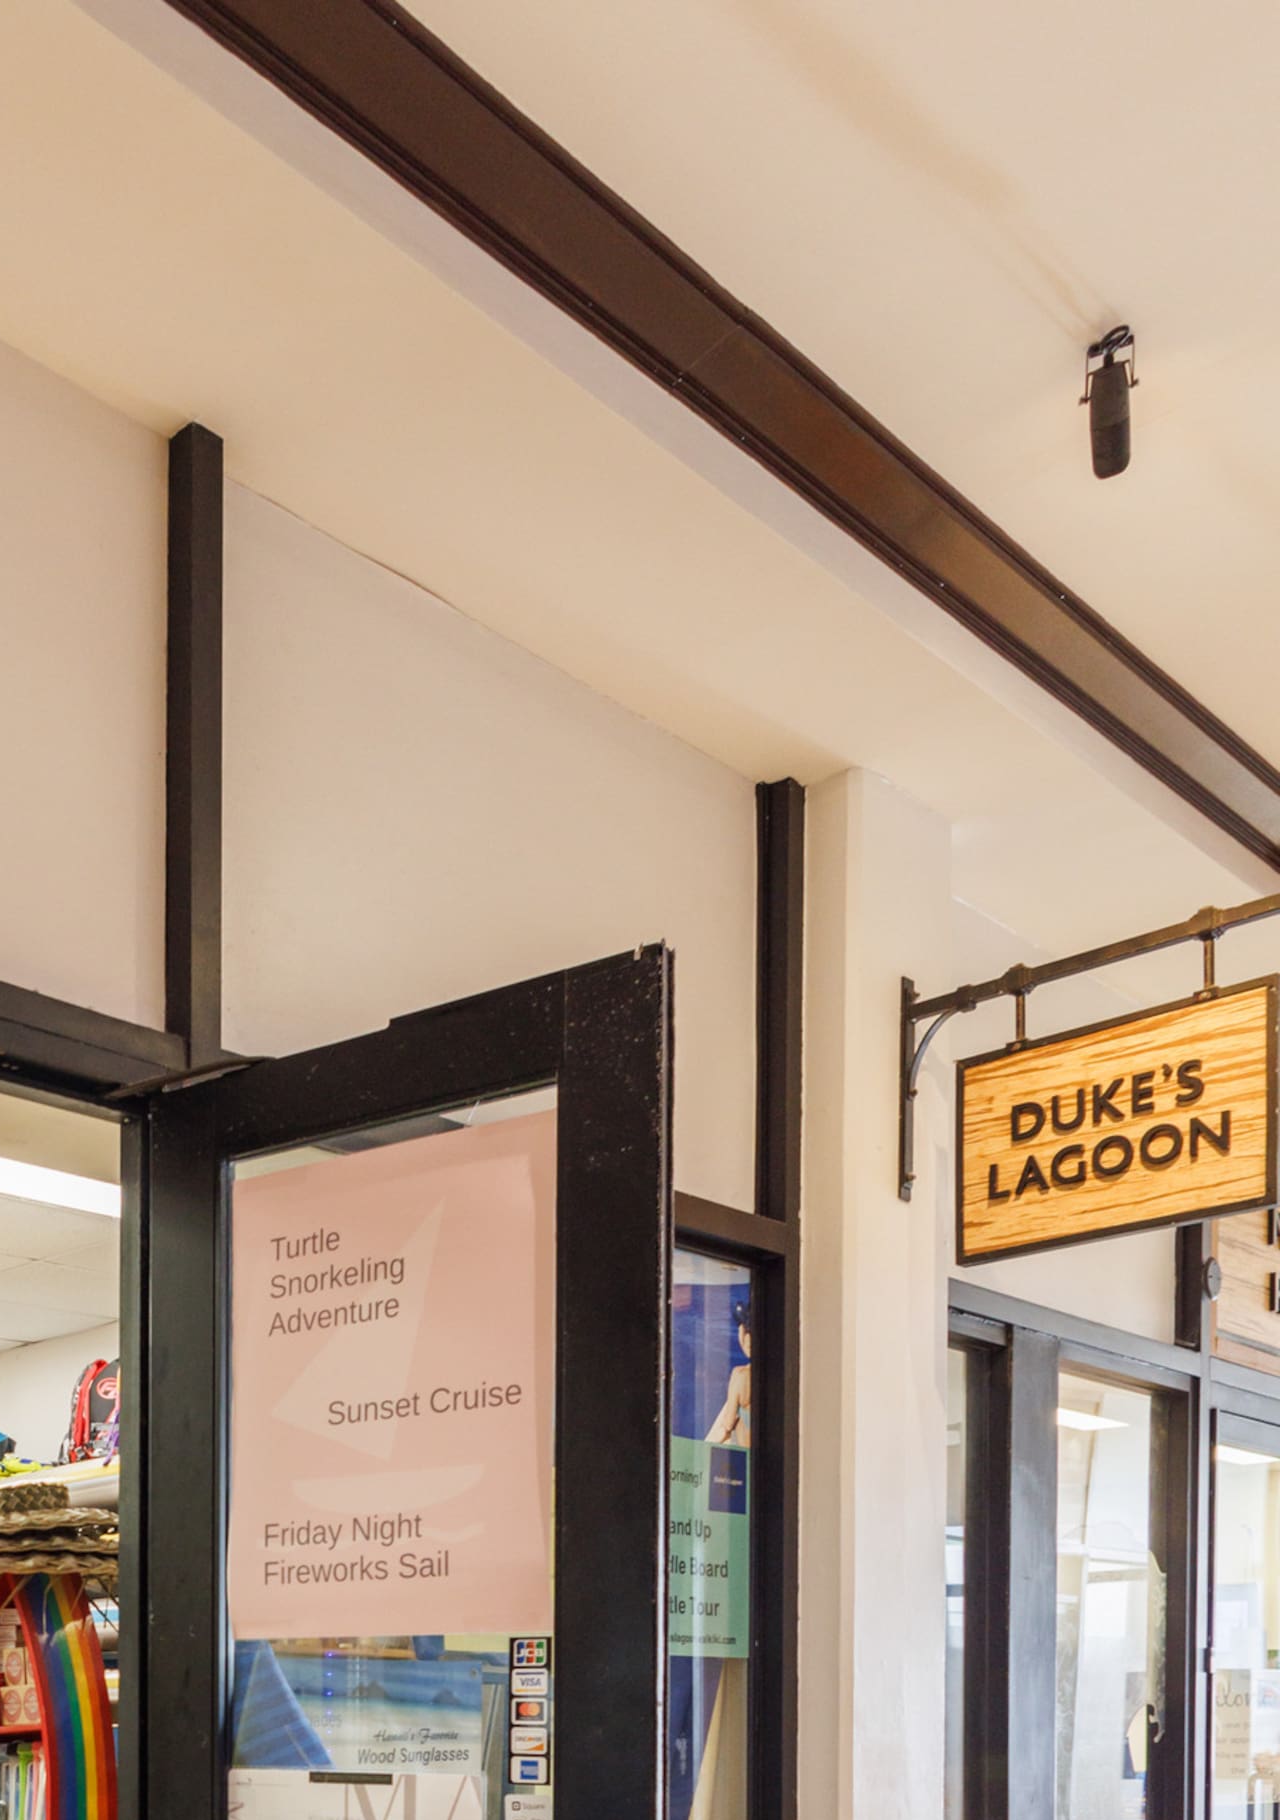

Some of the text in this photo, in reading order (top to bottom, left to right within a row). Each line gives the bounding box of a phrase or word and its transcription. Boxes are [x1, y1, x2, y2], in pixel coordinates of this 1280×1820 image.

[1010, 1059, 1205, 1144] DUKE'S
[987, 1110, 1232, 1205] LAGOON
[270, 1228, 341, 1262] Turtle
[270, 1256, 406, 1300] Snorkeling
[269, 1297, 400, 1337] Adventure
[327, 1381, 523, 1426] Sunset Cruise
[263, 1512, 423, 1551] Friday Night
[695, 1519, 712, 1543] Up
[263, 1549, 450, 1586] Fireworks Sail
[690, 1557, 729, 1578] Board
[520, 1677, 542, 1688] VISA
[358, 1746, 470, 1766] Wood Sunglasses
